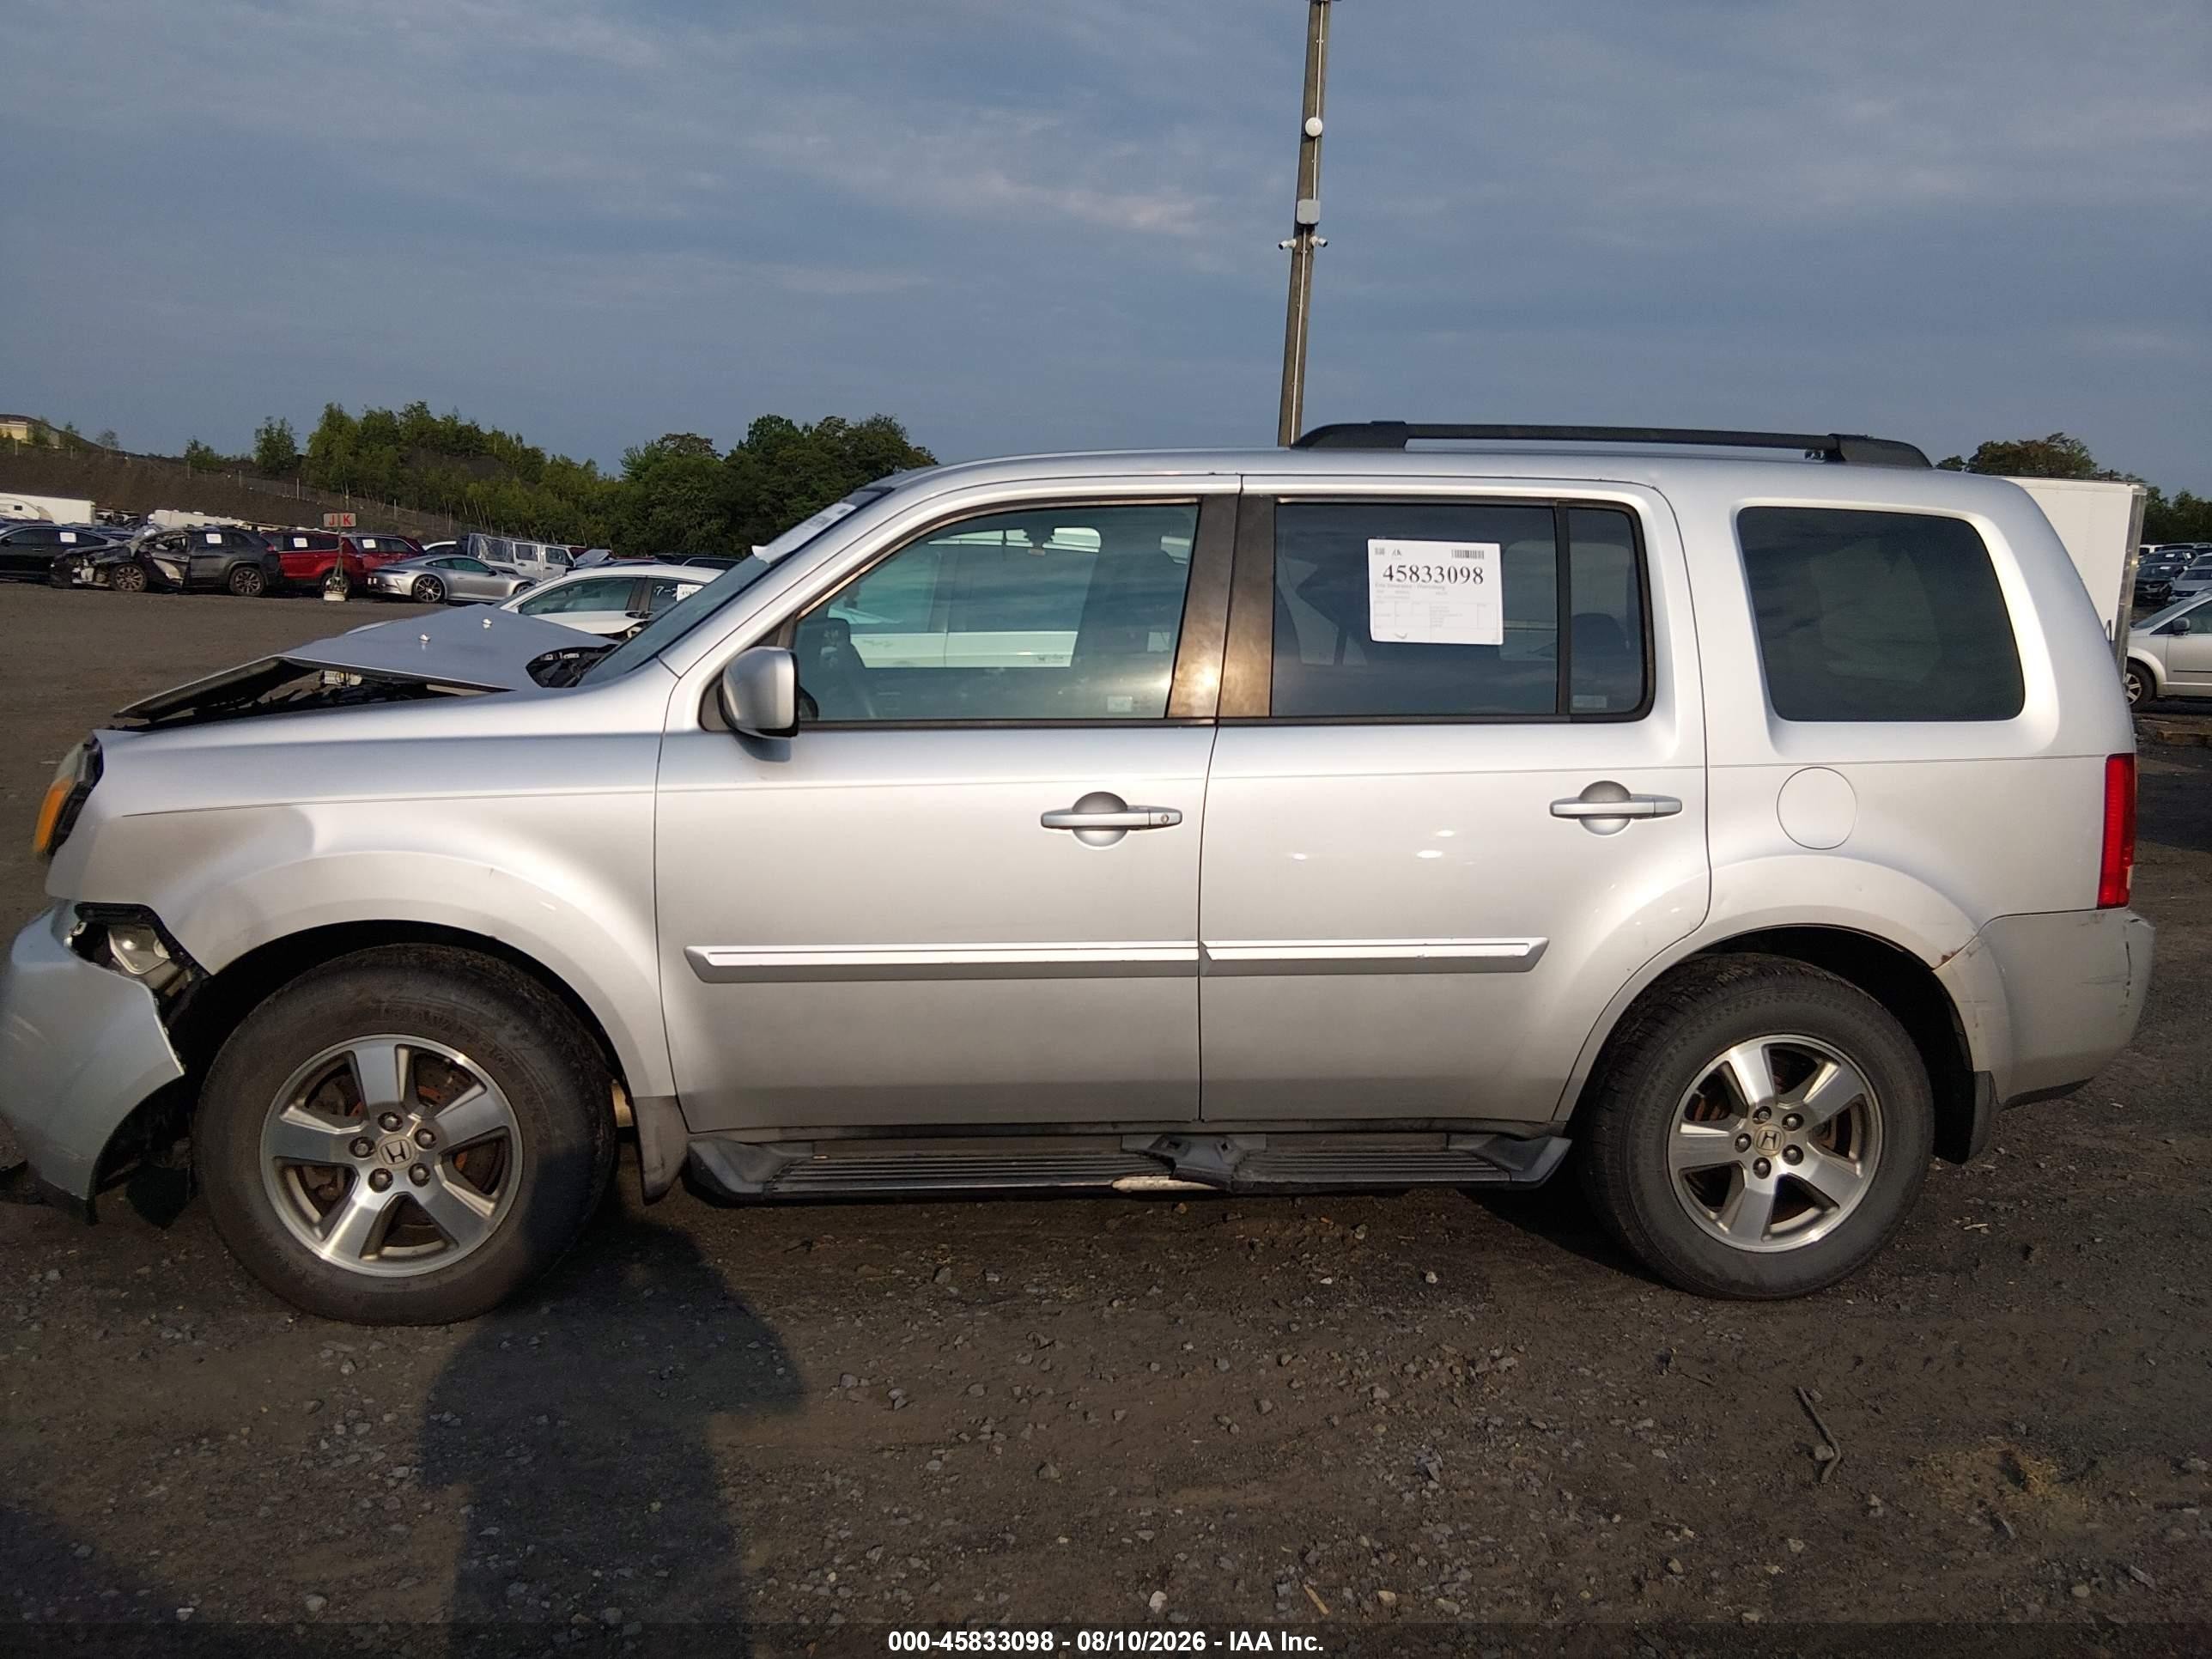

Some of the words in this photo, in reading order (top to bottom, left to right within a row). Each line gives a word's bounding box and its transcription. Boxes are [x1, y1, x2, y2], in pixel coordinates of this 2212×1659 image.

[329, 514, 335, 526] J
[343, 514, 352, 526] K
[1382, 564, 1484, 585] 45833098
